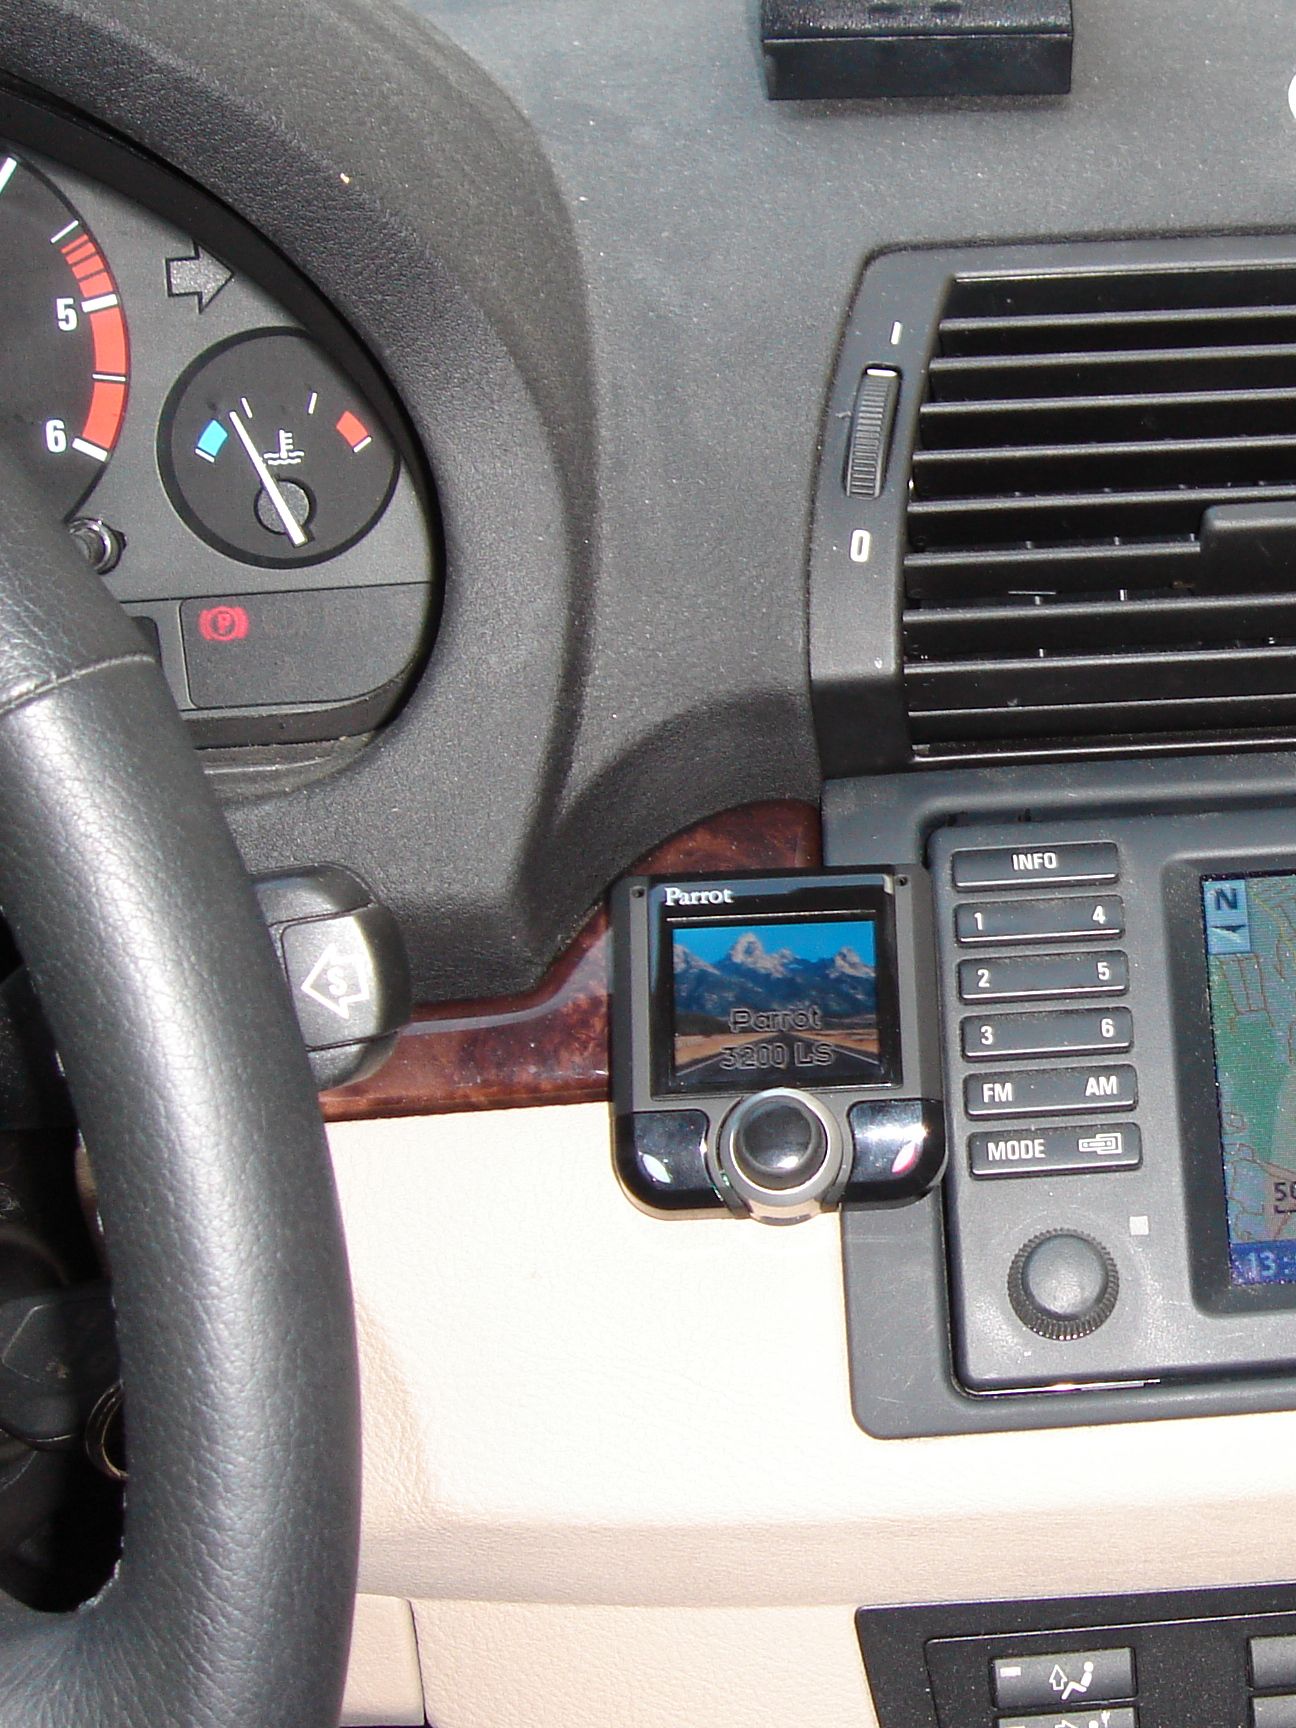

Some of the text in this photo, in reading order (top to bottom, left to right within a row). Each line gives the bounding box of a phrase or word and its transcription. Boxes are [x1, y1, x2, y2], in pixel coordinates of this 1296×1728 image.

[56, 297, 78, 332] 5
[45, 419, 67, 453] 6
[1012, 852, 1057, 871] INFO
[664, 887, 734, 906] Parrot
[1214, 888, 1238, 910] N
[973, 905, 1107, 931] 1 4
[977, 961, 1113, 988] 2 5
[728, 1004, 822, 1033] Parrot
[980, 1018, 1117, 1046] 3 6
[719, 1041, 835, 1070] 3200 LS
[982, 1076, 1119, 1103] FM AM
[987, 1139, 1046, 1161] MODE
